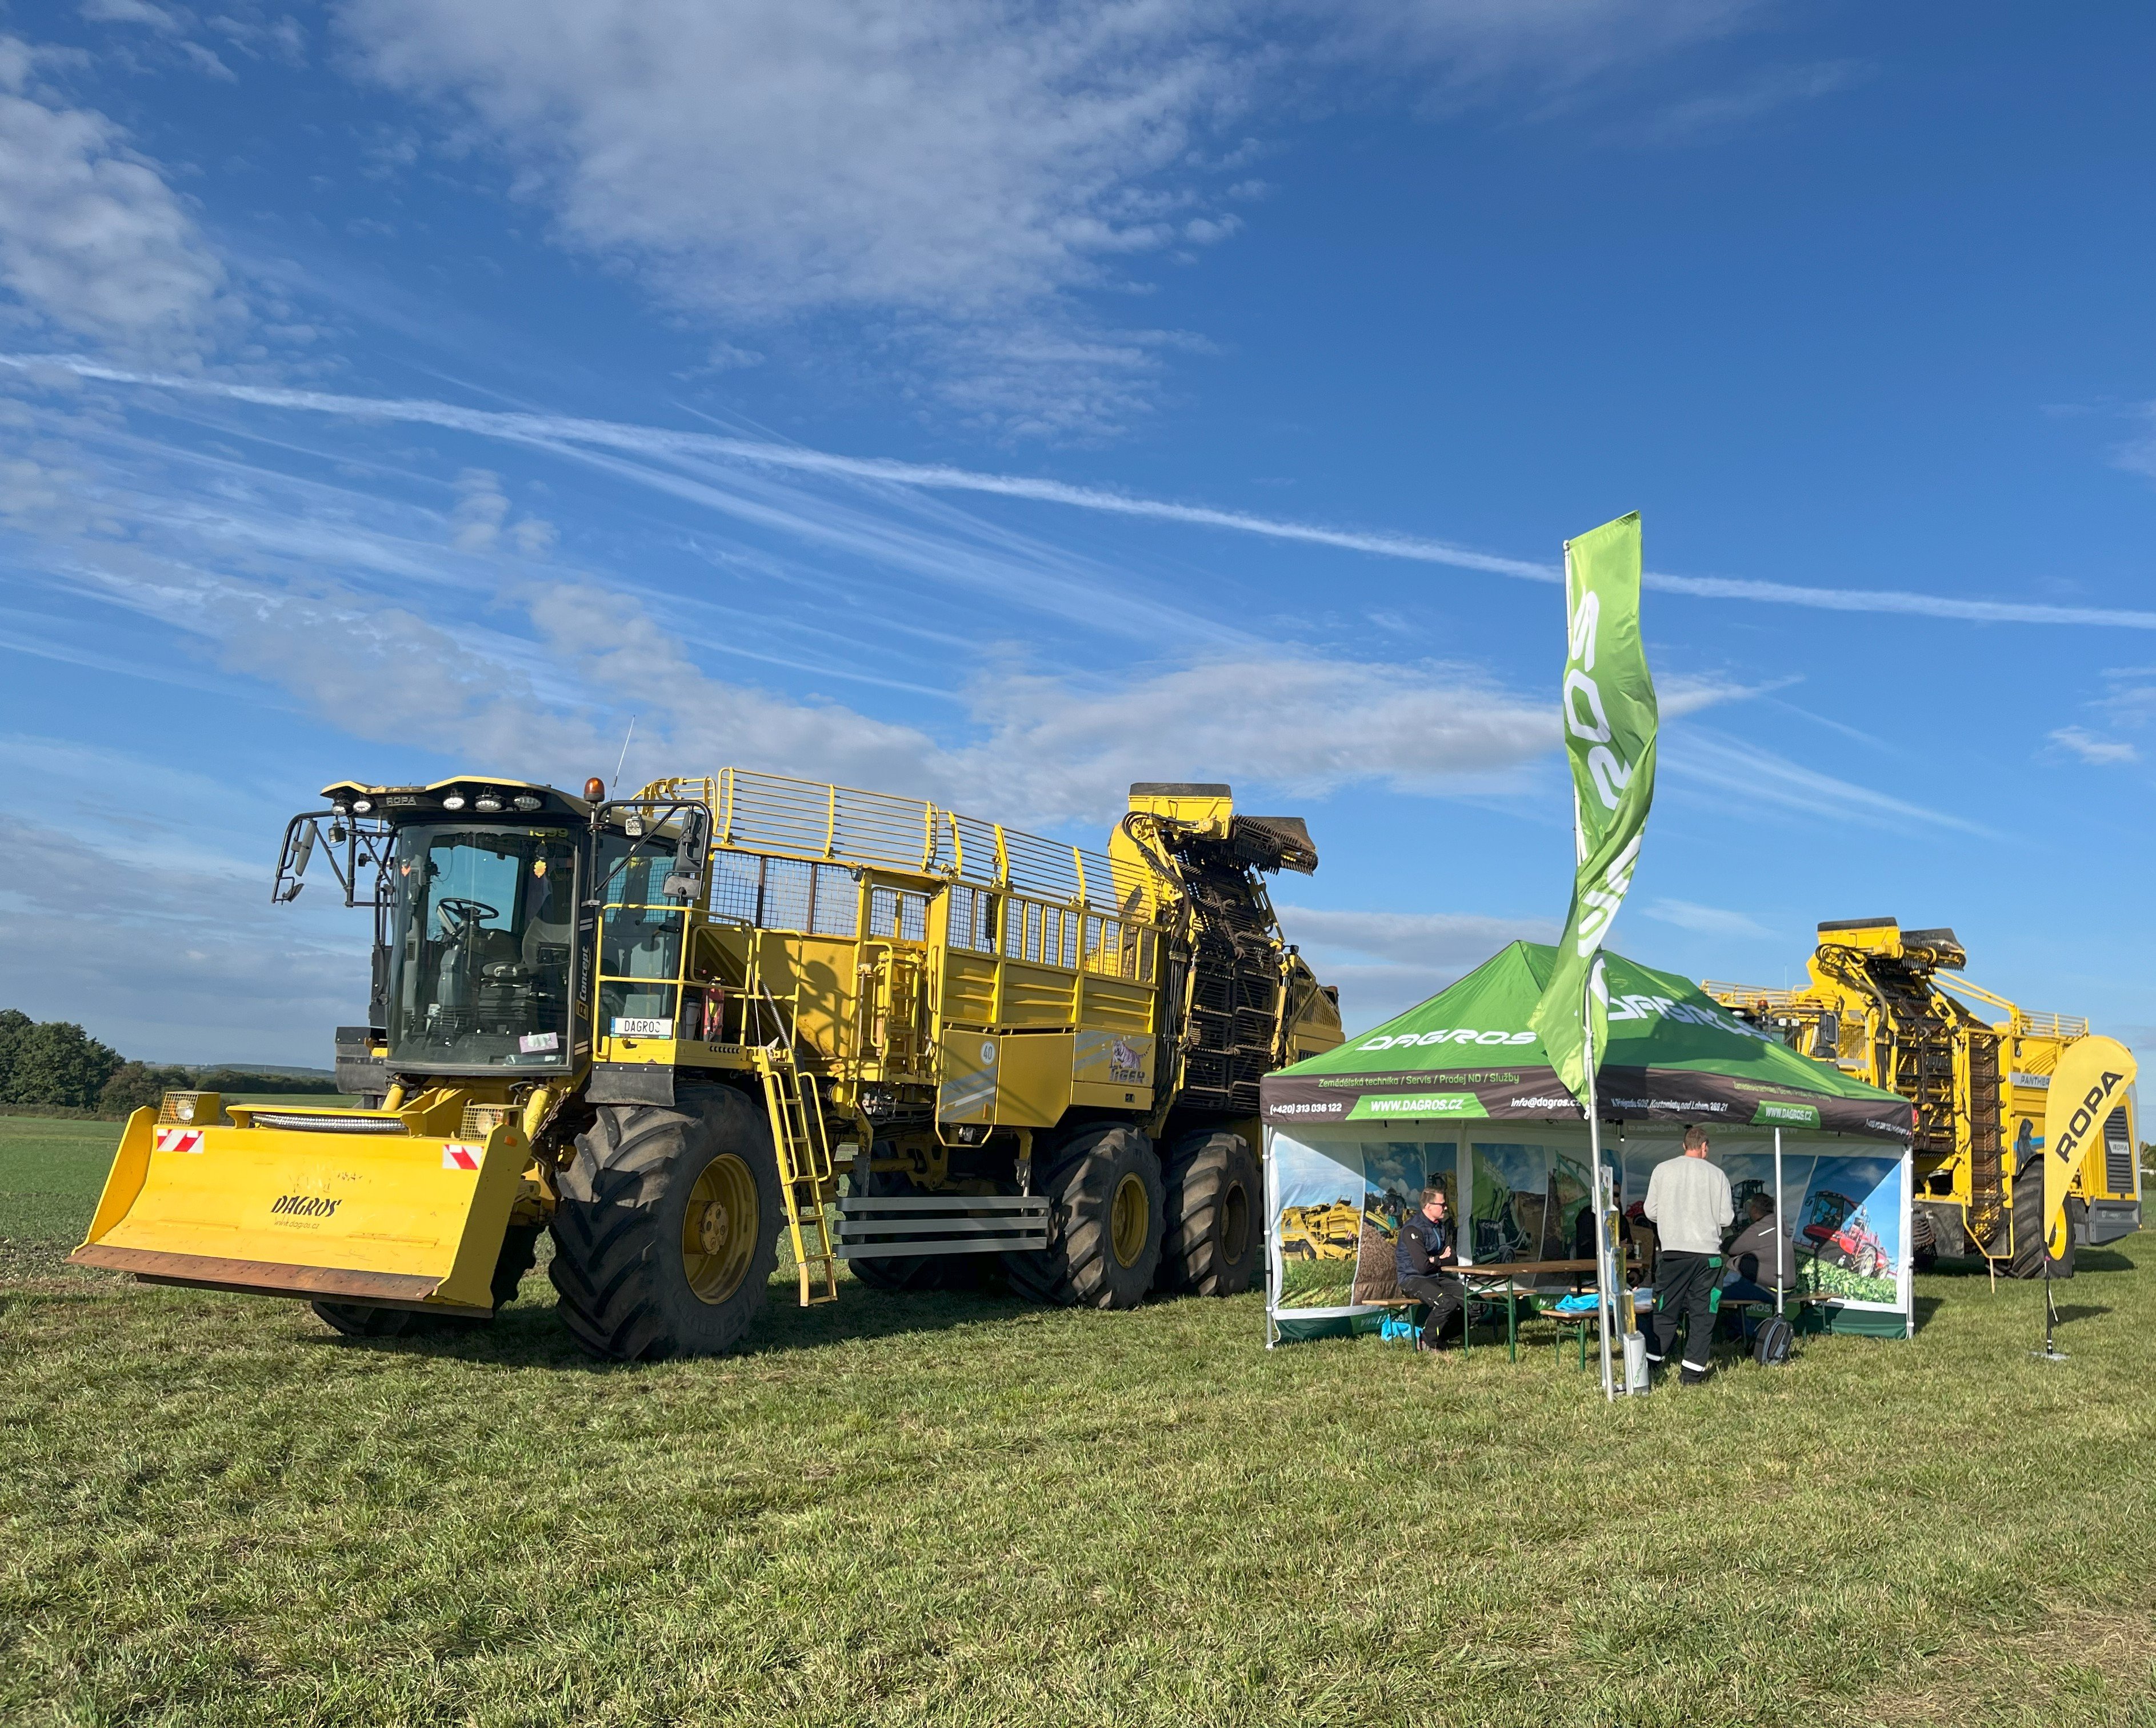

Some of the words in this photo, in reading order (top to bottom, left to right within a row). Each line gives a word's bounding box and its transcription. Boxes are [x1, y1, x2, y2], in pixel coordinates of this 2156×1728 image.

[386, 797, 417, 806] ROPA
[579, 946, 590, 1001] Concept
[625, 1020, 661, 1033] DAGROS
[1355, 1029, 1537, 1051] DAGROS
[983, 1045, 993, 1059] 40
[1109, 1066, 1145, 1084] TIGER
[1318, 1077, 1363, 1087] Zemědělská
[1365, 1076, 1398, 1086] technika
[1406, 1075, 1431, 1085] Servis
[1439, 1074, 1466, 1085] Prodej
[1468, 1074, 1481, 1083] ND
[1490, 1073, 1519, 1084] Služby
[2020, 1075, 2050, 1086] PANTHER
[1270, 1103, 1295, 1115] (+420)
[1296, 1104, 1310, 1113] 313
[1311, 1103, 1327, 1113] 036
[1328, 1103, 1342, 1112] 122
[1371, 1099, 1463, 1111] WWW.DAGROS.CZ
[1510, 1097, 1581, 1109] info@dagros.cz
[1766, 1107, 1813, 1121] WWW.DAGROS.CZ
[2055, 1071, 2124, 1163] ROPA
[270, 1195, 342, 1217] DAGROS
